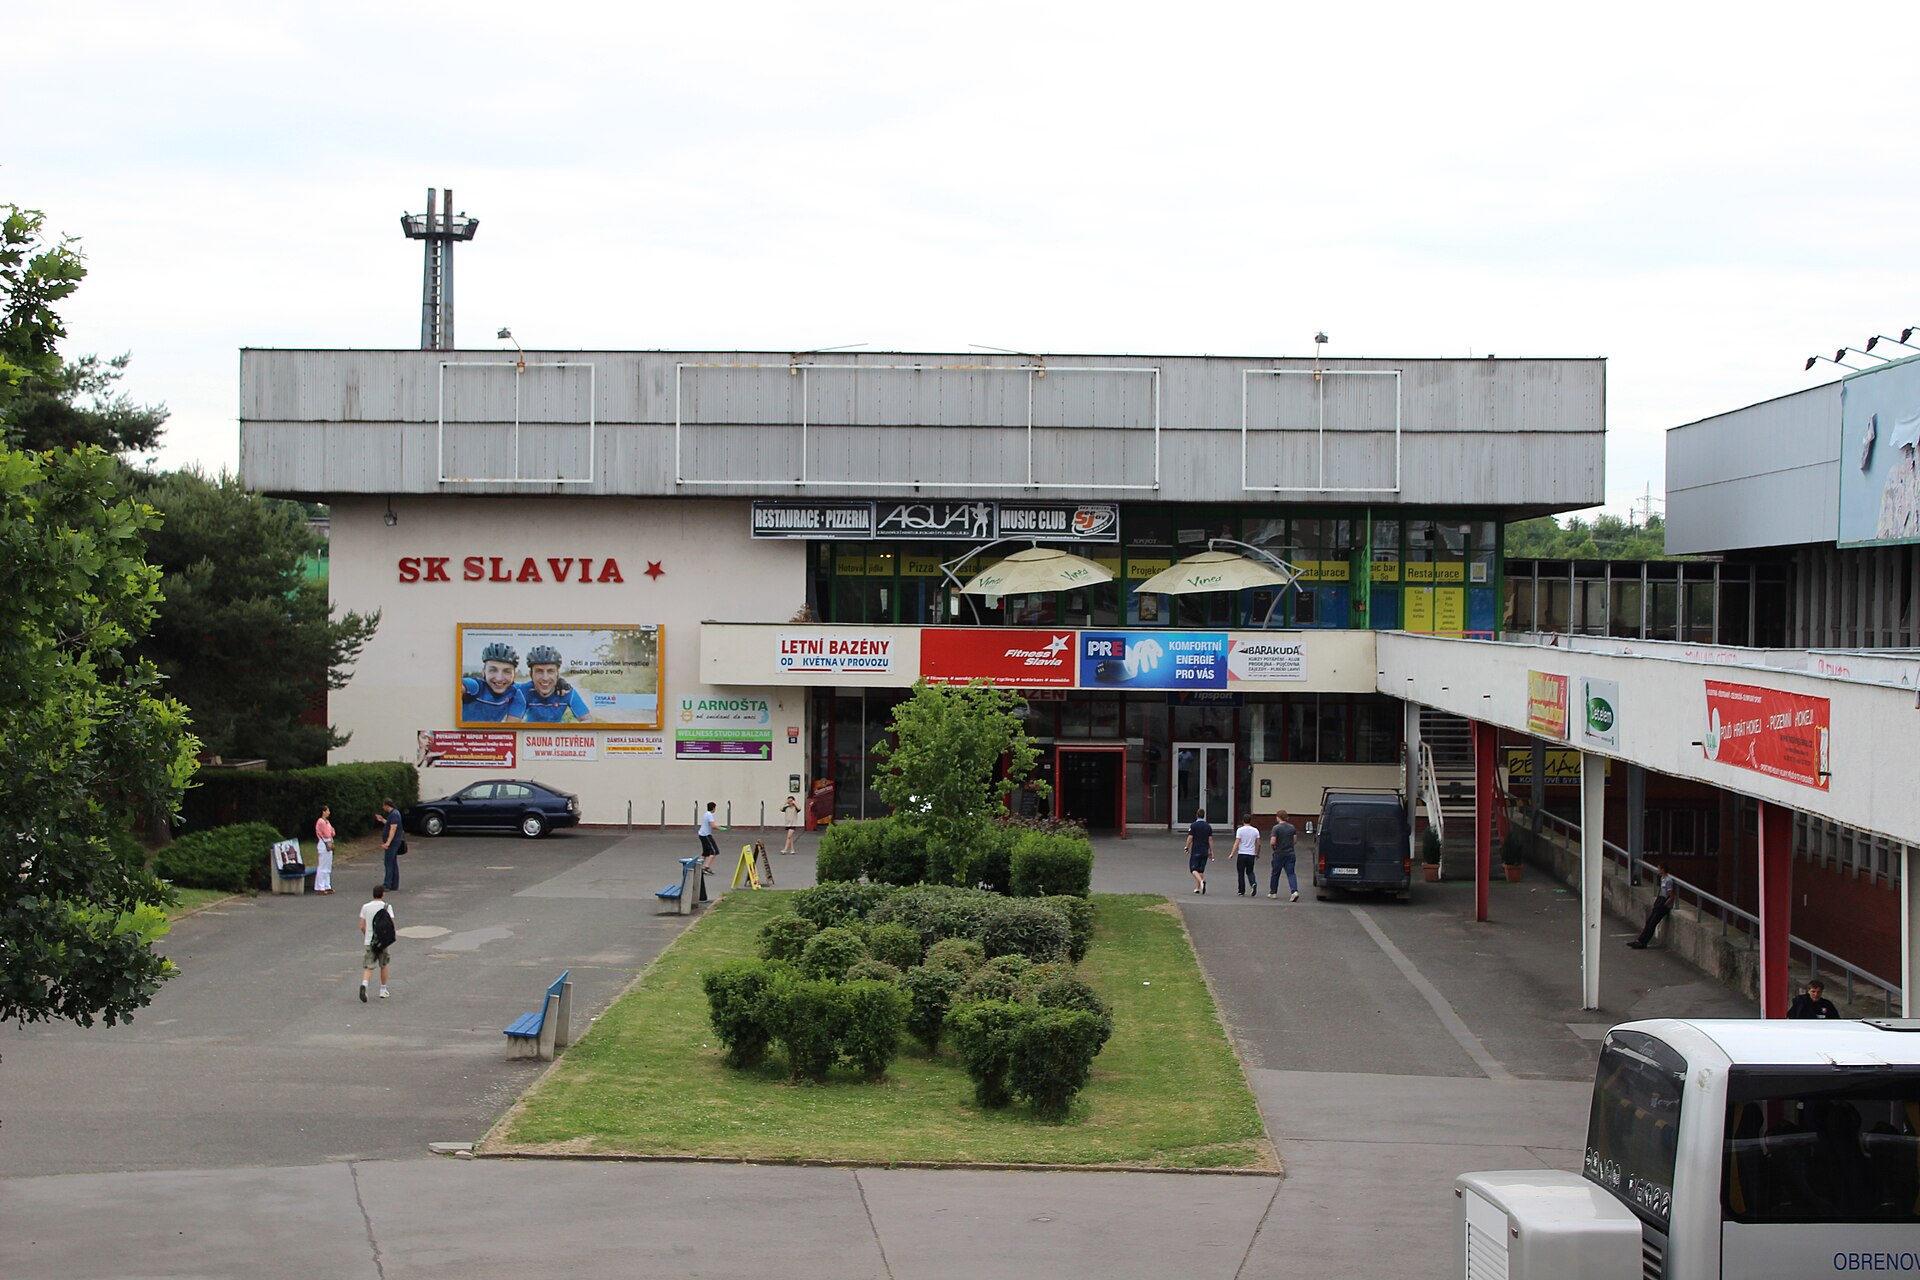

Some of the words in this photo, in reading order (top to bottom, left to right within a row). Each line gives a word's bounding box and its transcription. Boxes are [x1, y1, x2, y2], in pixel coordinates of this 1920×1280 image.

[755, 509, 819, 529] RESTAURACE
[826, 510, 870, 529] PIZZERIA
[877, 504, 969, 529] AQUA
[1000, 510, 1037, 530] MUSIC
[1038, 510, 1066, 530] CLUB
[398, 556, 451, 583] SK
[463, 556, 624, 583] SLAVIA
[908, 561, 934, 573] Pizza
[1383, 562, 1396, 572] bar
[1407, 567, 1460, 579] Restaurace
[1060, 568, 1089, 582] Vinea
[1187, 575, 1223, 587] Vinea
[781, 637, 824, 655] LETNÍ
[829, 638, 890, 655] BAZÉNY
[1087, 640, 1124, 657] PRE
[1169, 639, 1222, 651] KOMFORTNÍ
[1248, 645, 1300, 655] BARAKUDA
[1004, 649, 1051, 658] Fitness
[589, 660, 621, 668] pravidelné
[780, 657, 794, 666] OD
[802, 656, 838, 667] KVĚTNA
[839, 658, 846, 666] V
[847, 658, 889, 667] PROVOZU
[1024, 657, 1063, 667] Slavia
[1176, 655, 1215, 665] ENERGIE
[1175, 669, 1194, 680] PRO
[1196, 668, 1215, 680] VÁS
[682, 700, 693, 711] U
[697, 698, 769, 712] ARNOŠTA
[1591, 704, 1612, 724] Cetelem
[1733, 719, 1746, 738] HRÁT
[1746, 718, 1762, 736] HOKEJ
[526, 736, 553, 747] SAUNA
[555, 735, 595, 748] OTEVŘENA
